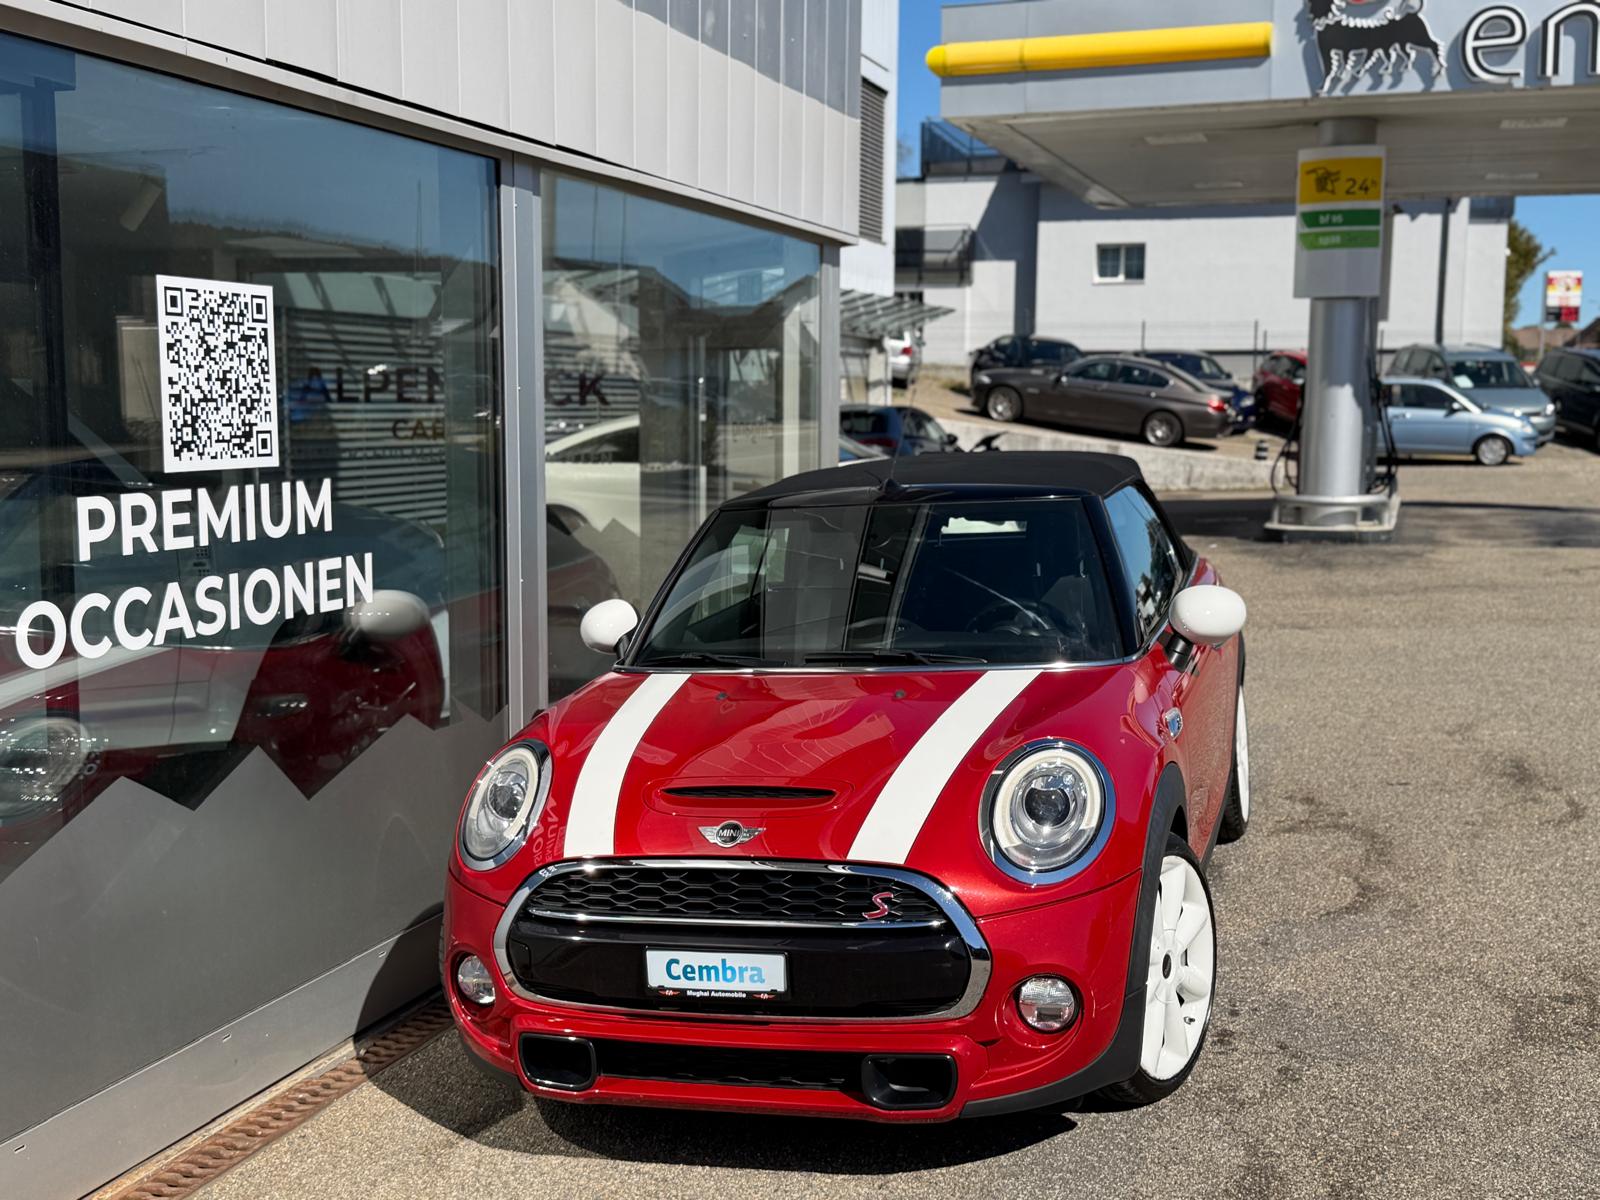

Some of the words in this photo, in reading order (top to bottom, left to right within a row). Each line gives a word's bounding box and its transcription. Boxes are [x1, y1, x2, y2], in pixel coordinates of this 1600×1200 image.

[76, 478, 333, 562] PREMIUM
[15, 552, 374, 669] OCCASIONEN
[718, 828, 740, 838] MINI
[862, 891, 894, 920] S
[665, 958, 766, 984] Cembra
[686, 990, 710, 998] Mughal
[710, 990, 747, 998] Automobile
